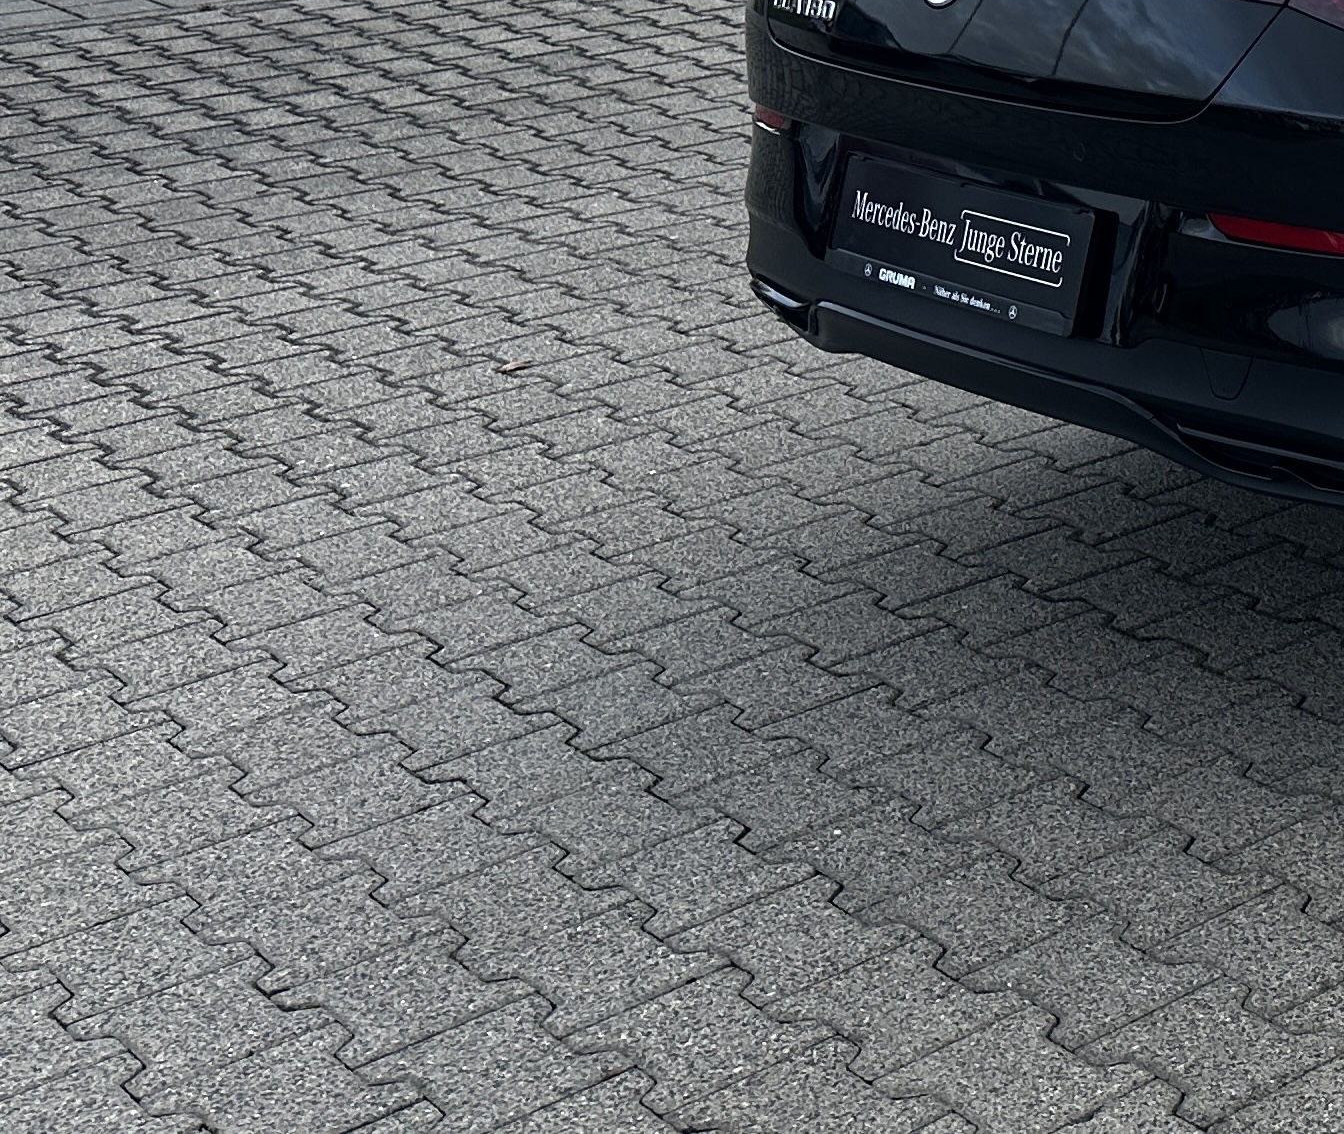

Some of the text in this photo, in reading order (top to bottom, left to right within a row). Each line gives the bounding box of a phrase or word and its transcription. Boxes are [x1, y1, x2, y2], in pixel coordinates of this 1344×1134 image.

[851, 190, 1063, 273] Mercedes-Benz Junge Sterne
[878, 268, 916, 290] GRUMA
